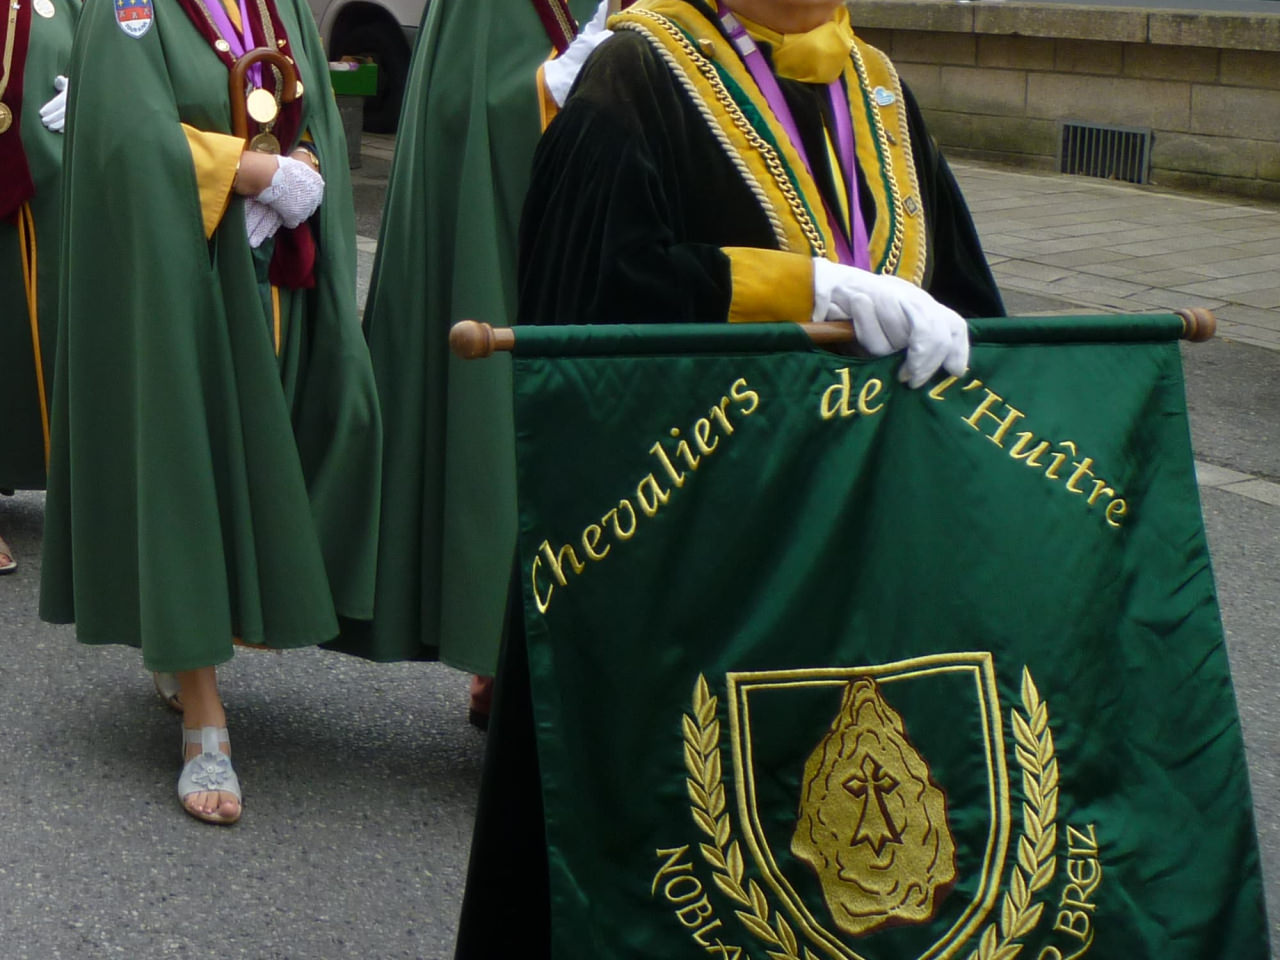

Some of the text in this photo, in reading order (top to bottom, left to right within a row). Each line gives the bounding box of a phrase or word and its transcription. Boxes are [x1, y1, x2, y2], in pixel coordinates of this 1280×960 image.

[530, 367, 1128, 615] Chevaliers de l'Huître
[651, 843, 750, 960] NOBLA
[1052, 823, 1102, 943] BREIZ
